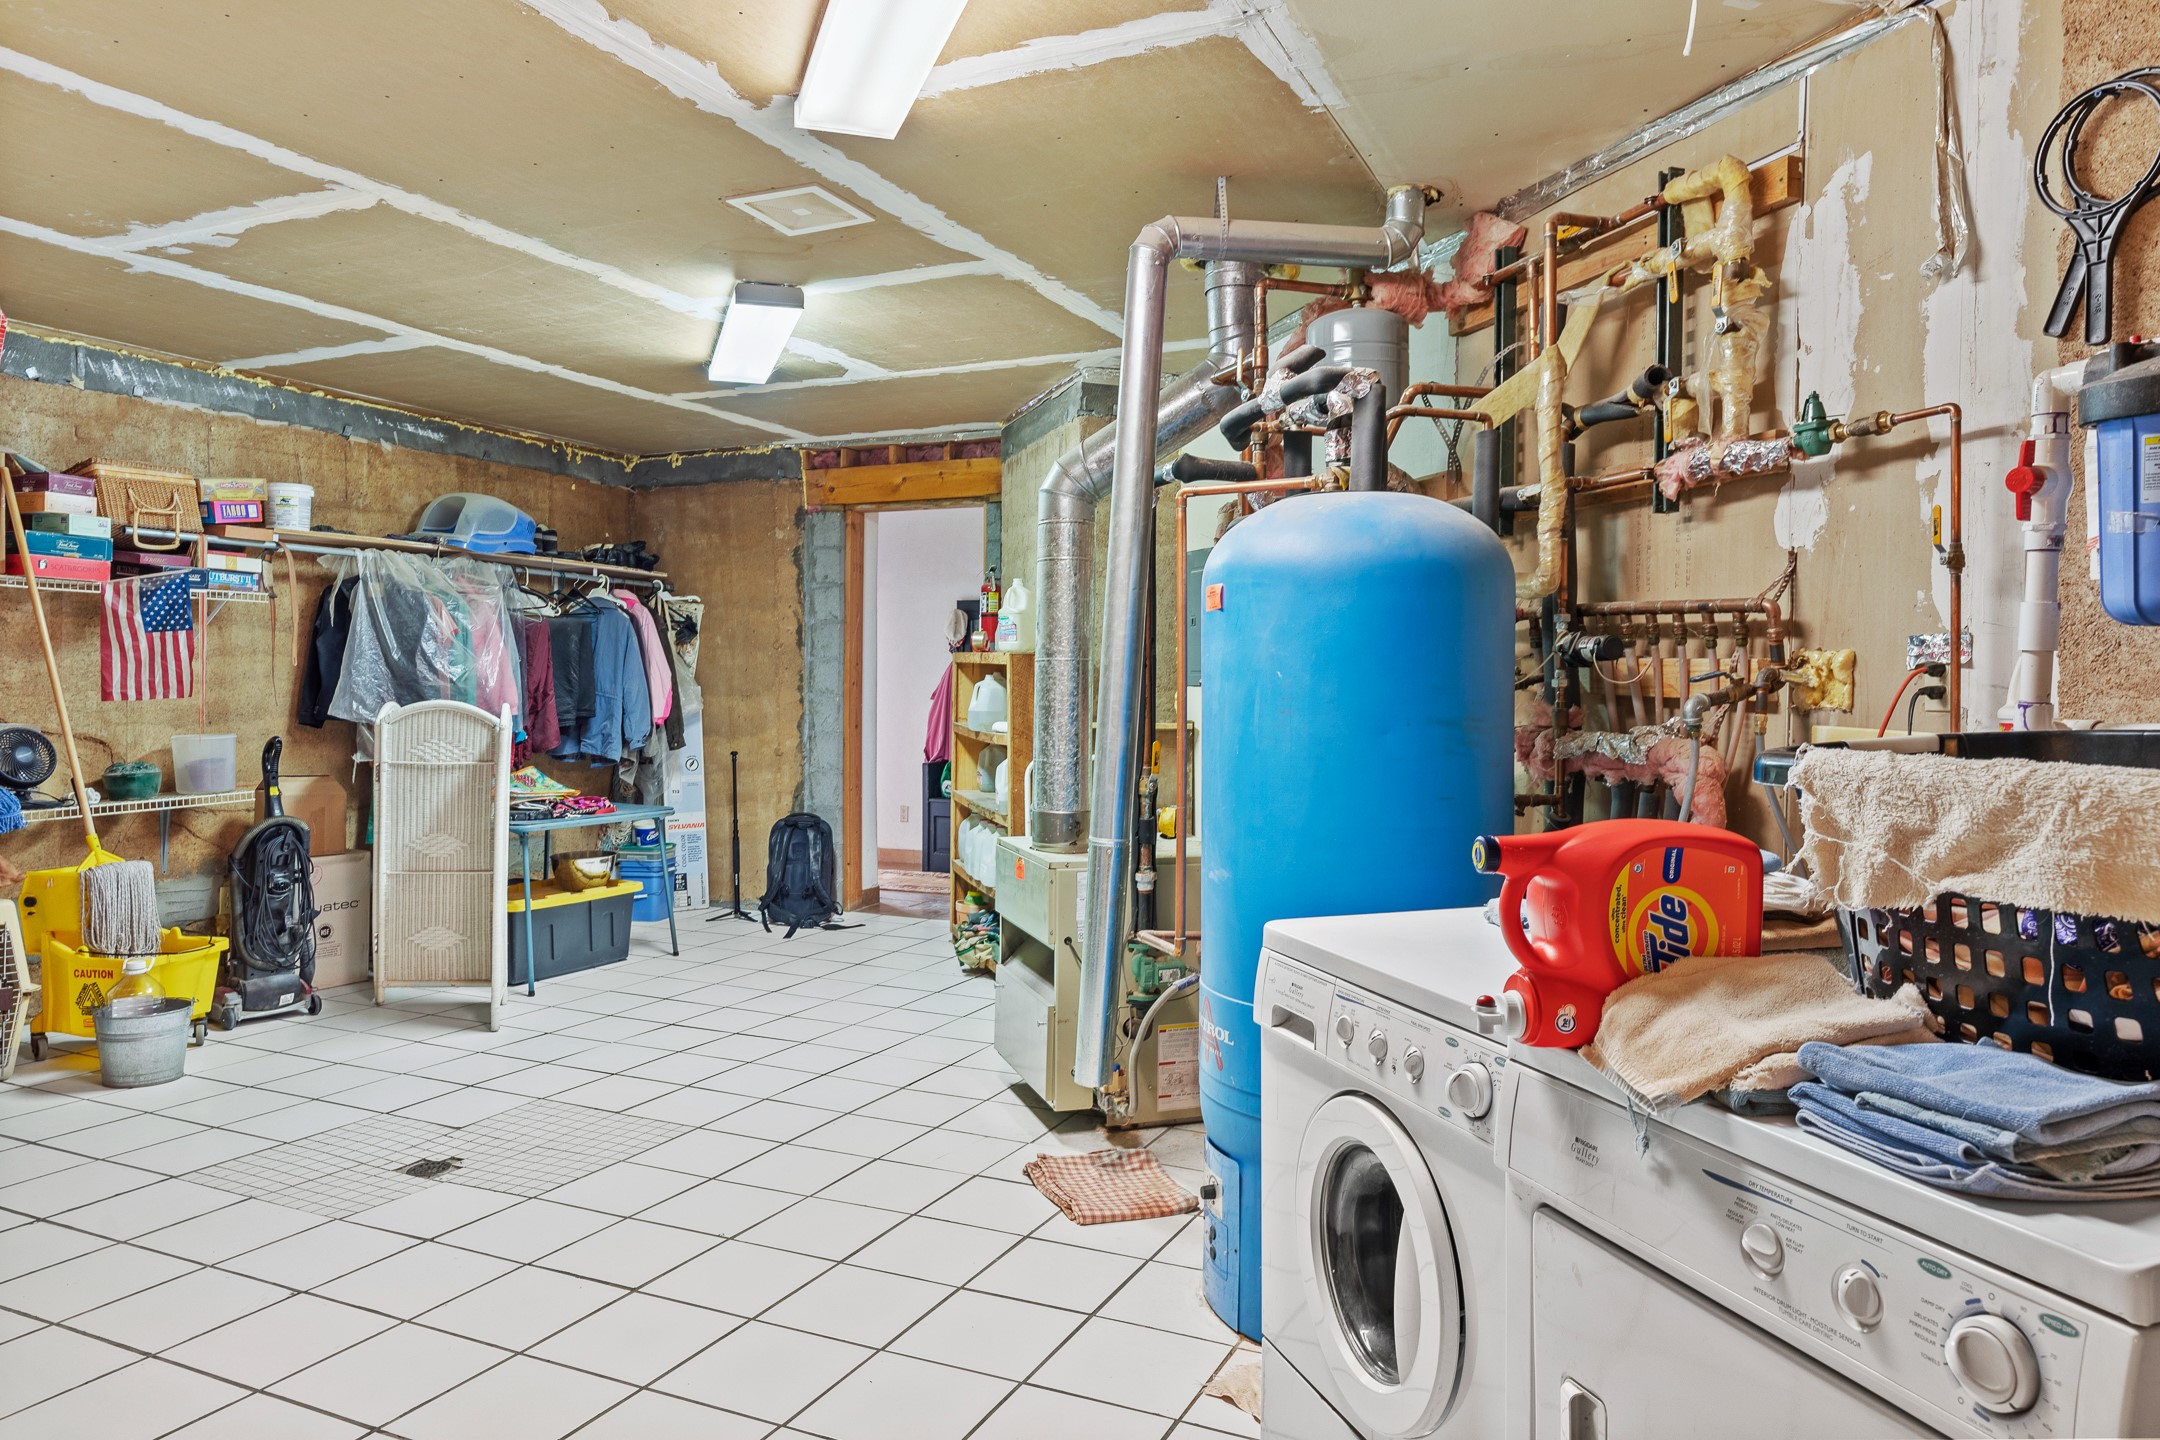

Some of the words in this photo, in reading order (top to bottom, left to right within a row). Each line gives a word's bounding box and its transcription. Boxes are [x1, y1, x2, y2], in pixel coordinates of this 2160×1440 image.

[222, 505, 246, 517] TABOO
[209, 571, 246, 584] UTBURST
[668, 822, 704, 830] SYLVANIA
[1669, 848, 1678, 880] ORIGINAL
[1614, 884, 1622, 944] concentrated,
[1648, 893, 1691, 973] Tide
[74, 969, 114, 979] CAUTION
[1571, 1142, 1600, 1166] Gallery
[1748, 1180, 1758, 1189] DRY
[1759, 1184, 1793, 1205] TEMPERATURE
[1776, 1221, 1784, 1229] LOW
[1784, 1224, 1795, 1233] HEAT
[1846, 1223, 1860, 1234] TURN
[1868, 1234, 1884, 1244] START
[1921, 1261, 1936, 1272] AUTO
[1936, 1267, 1949, 1277] DRY
[1753, 1286, 1776, 1302] INTERIOR
[1776, 1298, 1792, 1312] DRUM
[1792, 1307, 1807, 1319] LIGHT
[1810, 1317, 1837, 1336] MOISTURE
[1838, 1332, 1861, 1348] SENSOR
[1935, 1304, 1946, 1313] DRY
[1779, 1306, 1798, 1320] TUMBLE
[1799, 1318, 1812, 1330] CARE
[1812, 1325, 1834, 1341] DRYING
[1914, 1311, 1939, 1328] DELICATES
[1909, 1320, 1923, 1330] PERM
[1923, 1326, 1937, 1338] PRESS
[1914, 1331, 1936, 1346] REGULAR
[1920, 1352, 1941, 1367] TOWELS
